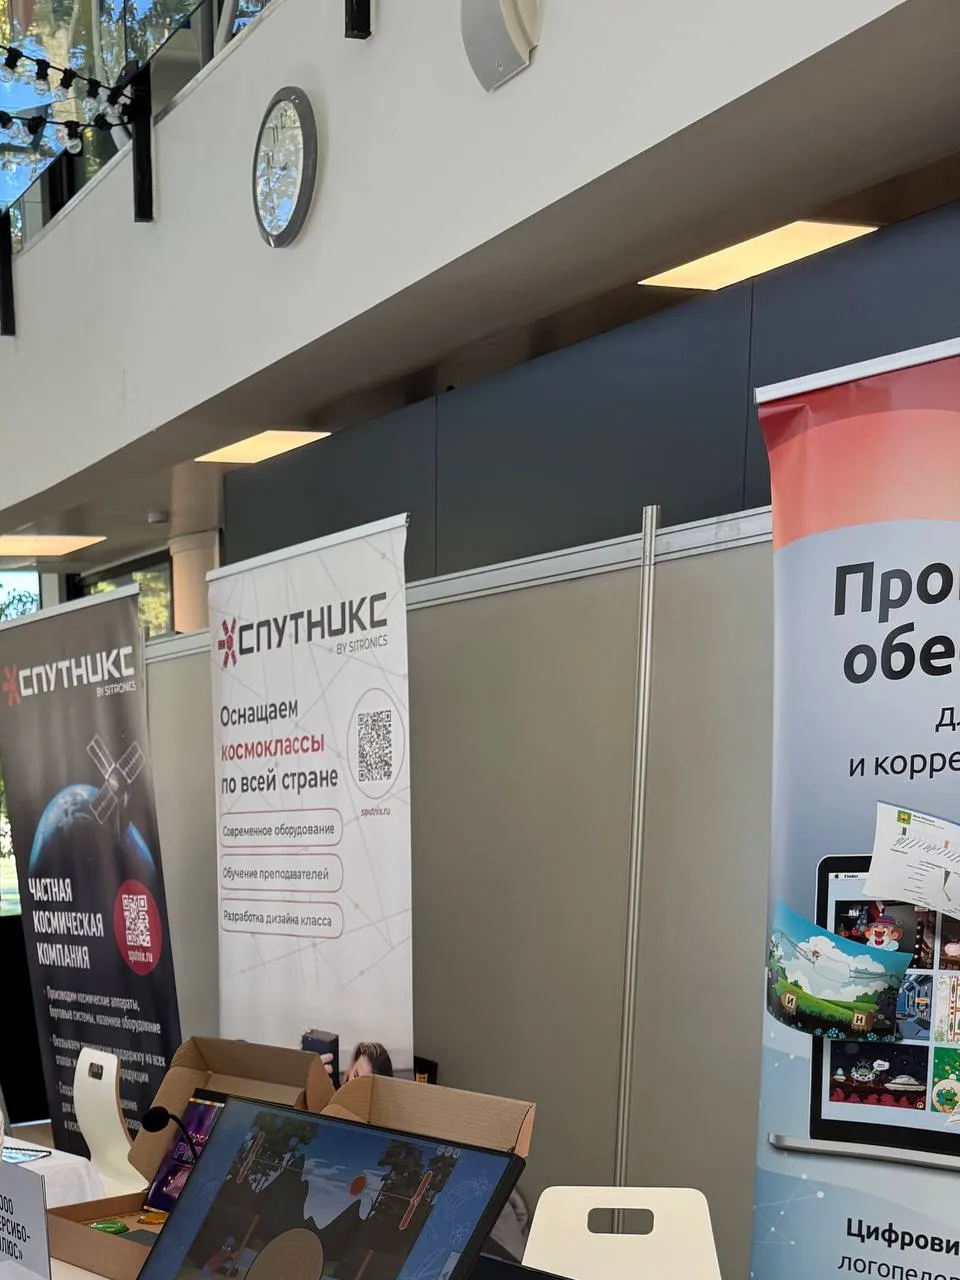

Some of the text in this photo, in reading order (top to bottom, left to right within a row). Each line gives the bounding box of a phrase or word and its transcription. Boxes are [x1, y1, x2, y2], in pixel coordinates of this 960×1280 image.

[834, 561, 960, 623] Про
[239, 592, 387, 655] СПУТНИКС
[336, 634, 388, 655] BY SITRONICS
[843, 622, 960, 684] обе
[19, 646, 135, 696] СПУТНИКС
[104, 681, 137, 696] SITRONICS
[220, 700, 298, 727] Оснащаем
[221, 734, 325, 761] космоклассы
[849, 757, 865, 777] и
[221, 768, 338, 795] по всей стране
[222, 823, 335, 841] Современное оборудование
[222, 867, 329, 882] Обучение преподавателей
[28, 878, 73, 902] ЧАСТНАЯ
[32, 910, 104, 937] КОСМИЧЕСКАЯ
[224, 909, 332, 927] Разработка дизайна класса
[36, 942, 90, 969] КОМПАНИЯ
[846, 1218, 960, 1256] Цифрови
